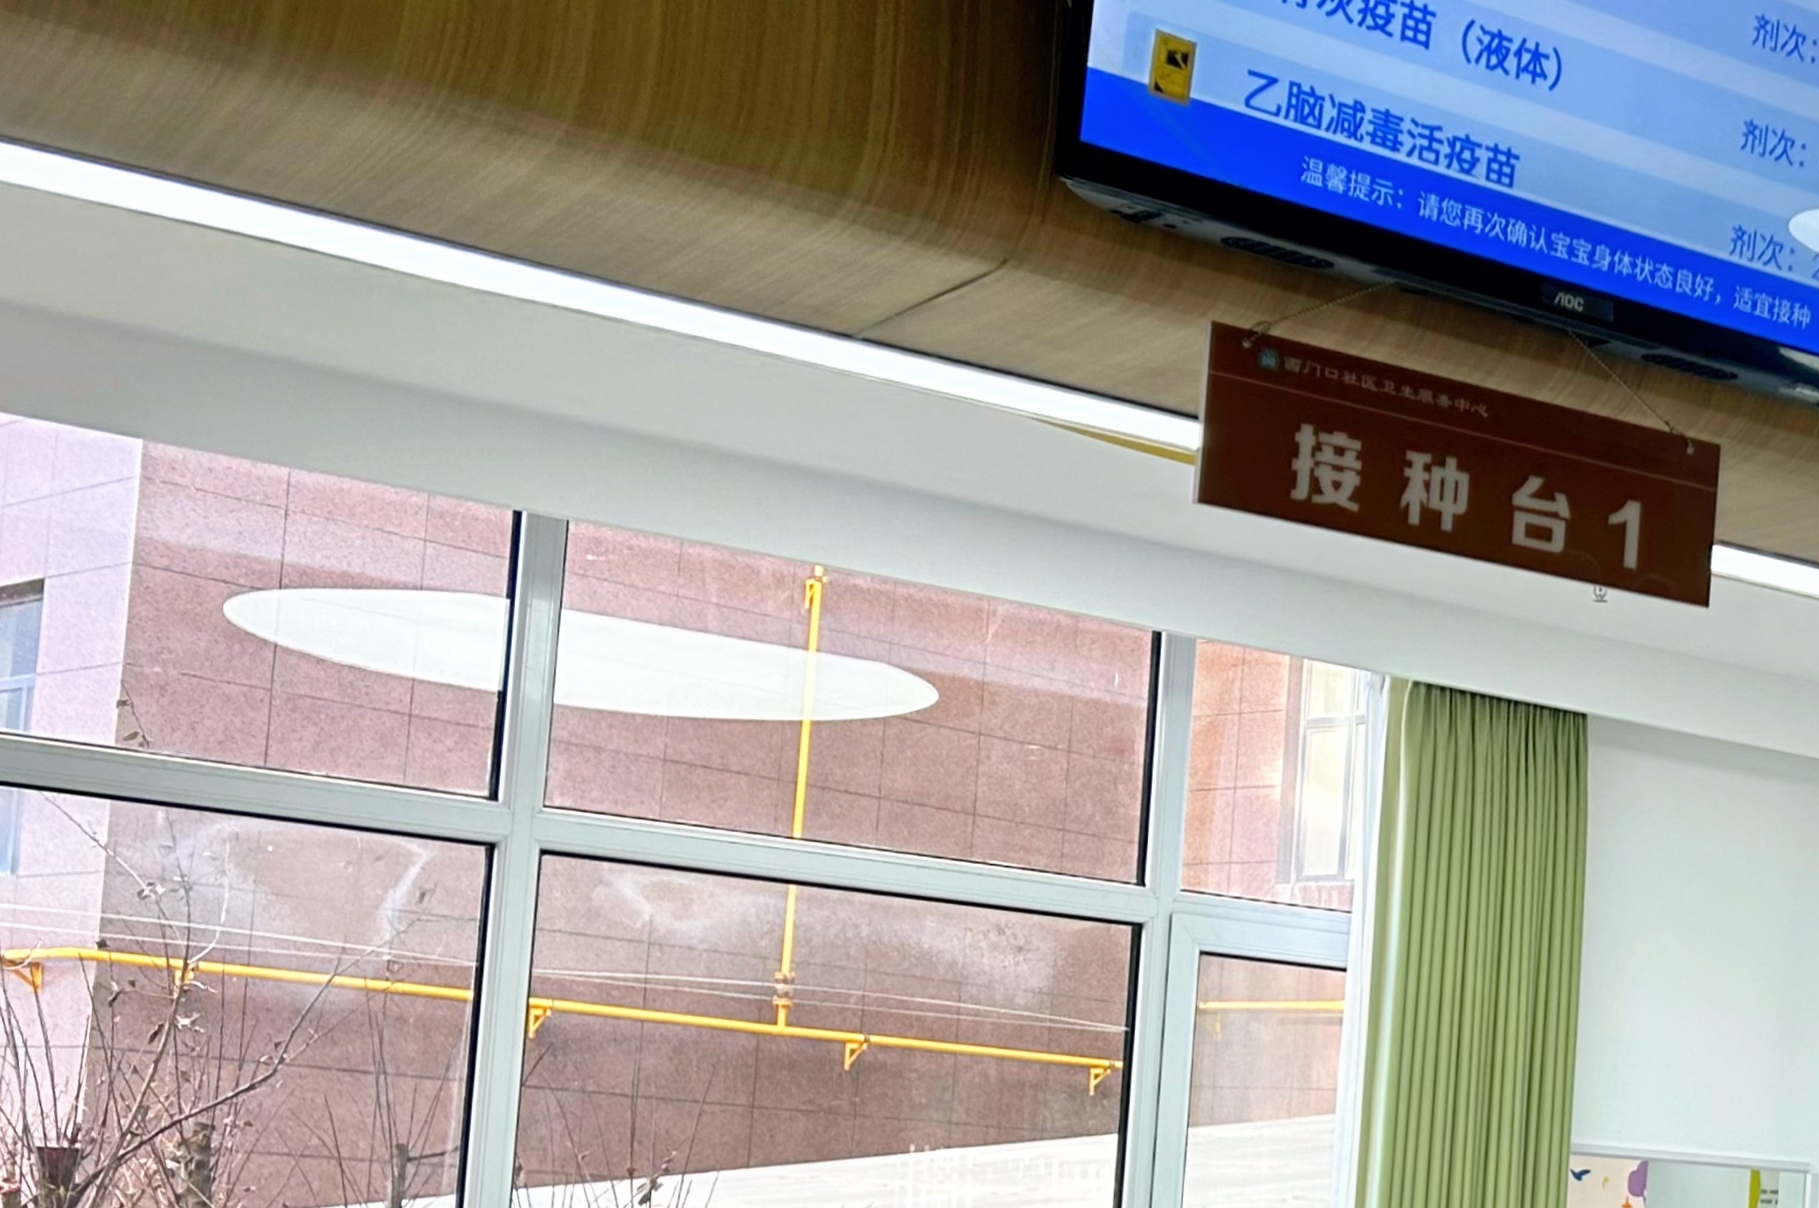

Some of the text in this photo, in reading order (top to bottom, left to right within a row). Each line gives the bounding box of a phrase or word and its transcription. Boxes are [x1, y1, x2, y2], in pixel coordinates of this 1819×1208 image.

[1244, 68, 1520, 189] 乙脑减毒活疫苗
[1289, 422, 1645, 570] 接种台1
